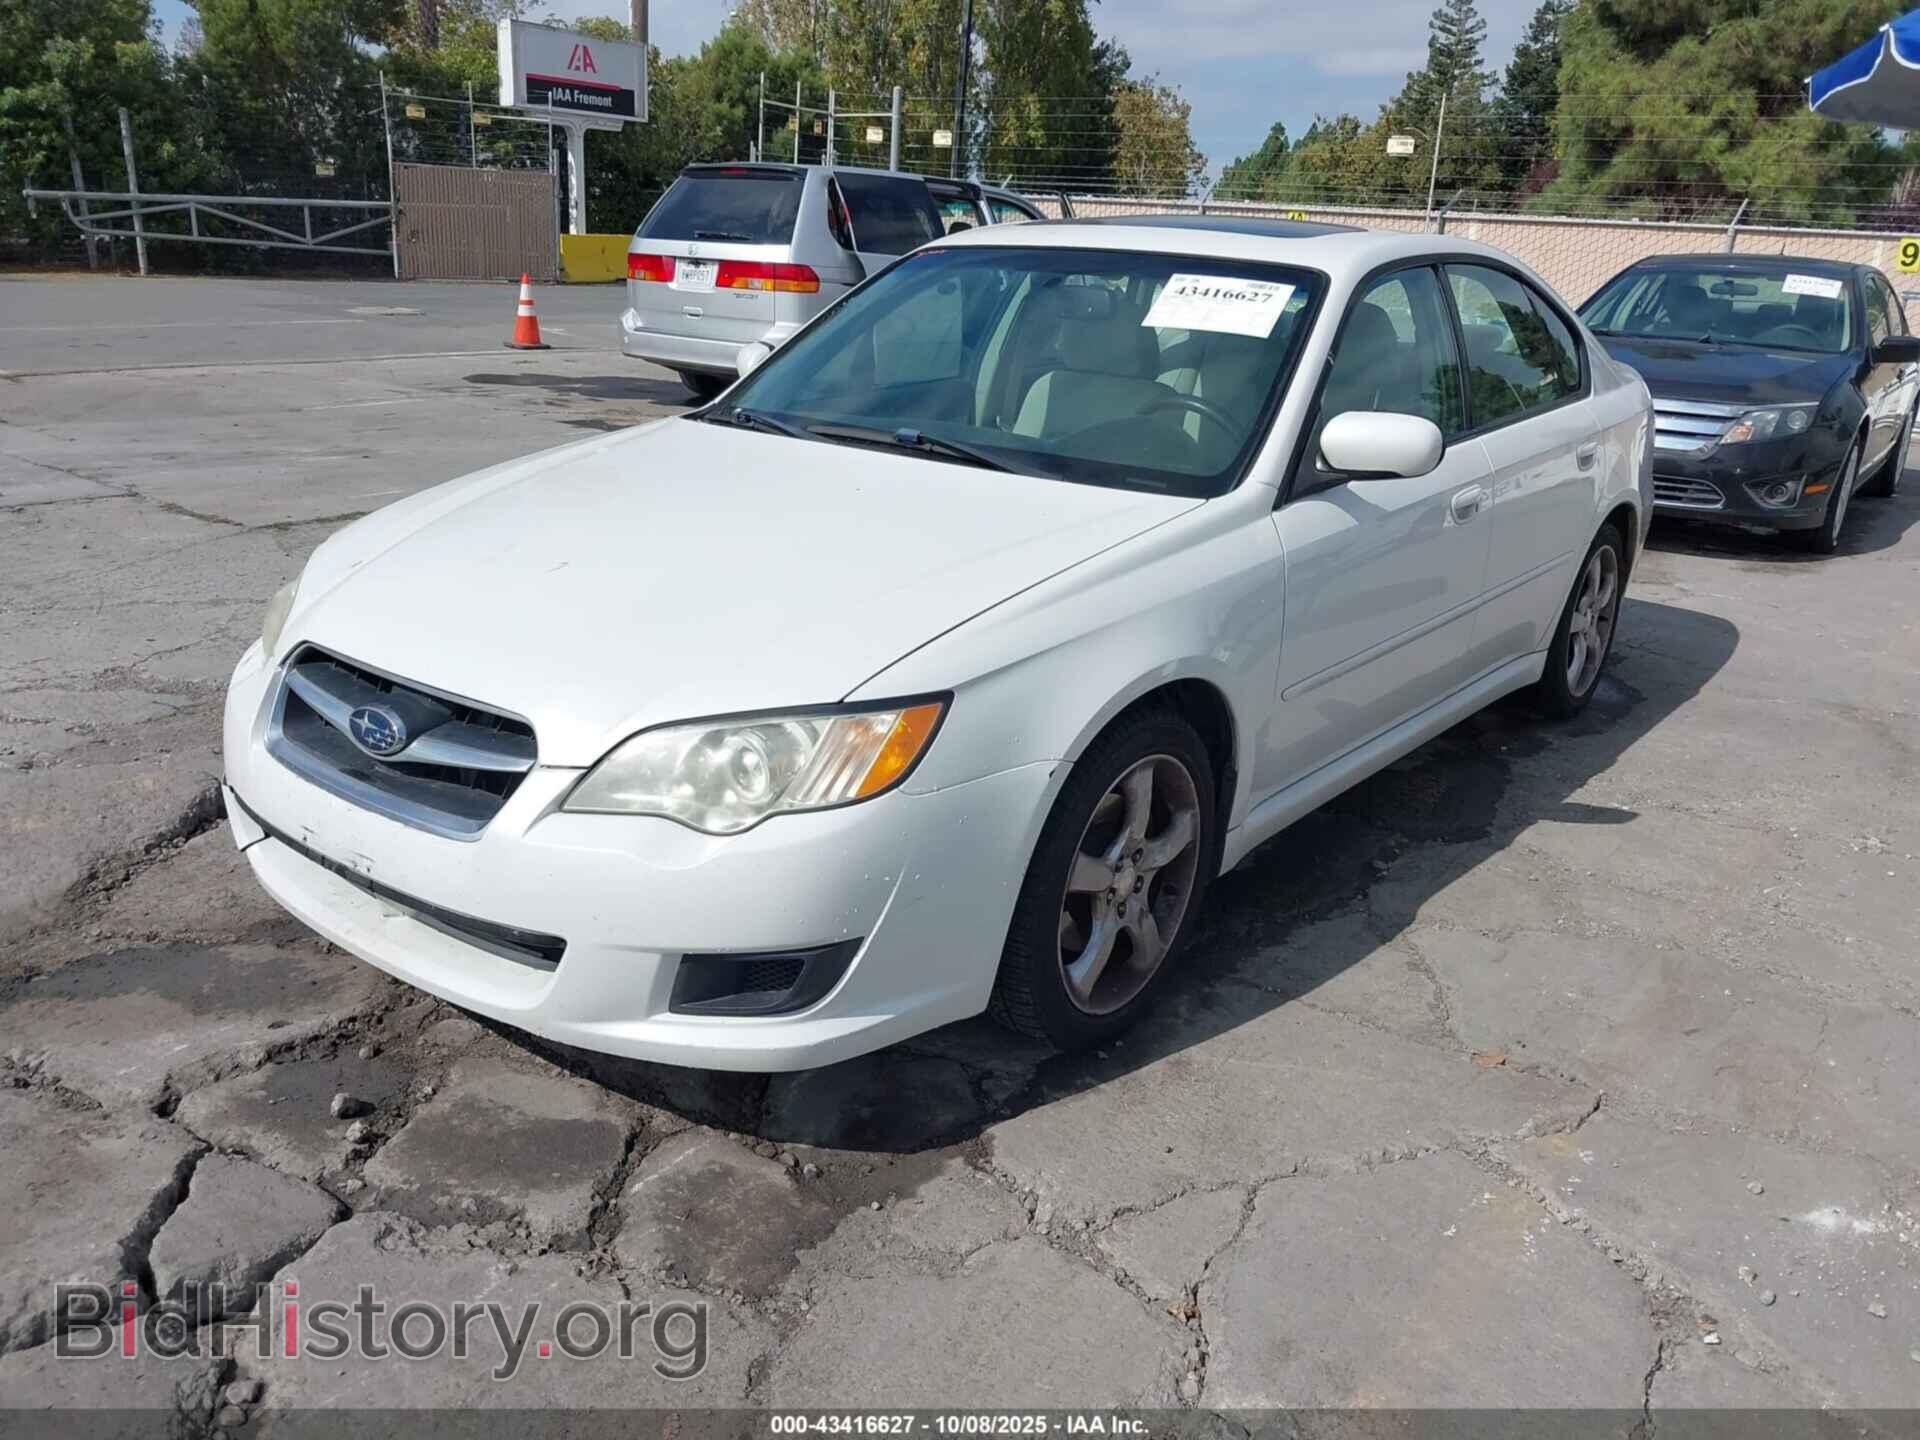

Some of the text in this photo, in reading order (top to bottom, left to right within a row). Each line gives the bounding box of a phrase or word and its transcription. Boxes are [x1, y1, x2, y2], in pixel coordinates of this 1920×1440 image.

[553, 87, 613, 108] IAA Fremont
[1900, 242, 1920, 267] 9
[1175, 286, 1273, 303] 43416627
